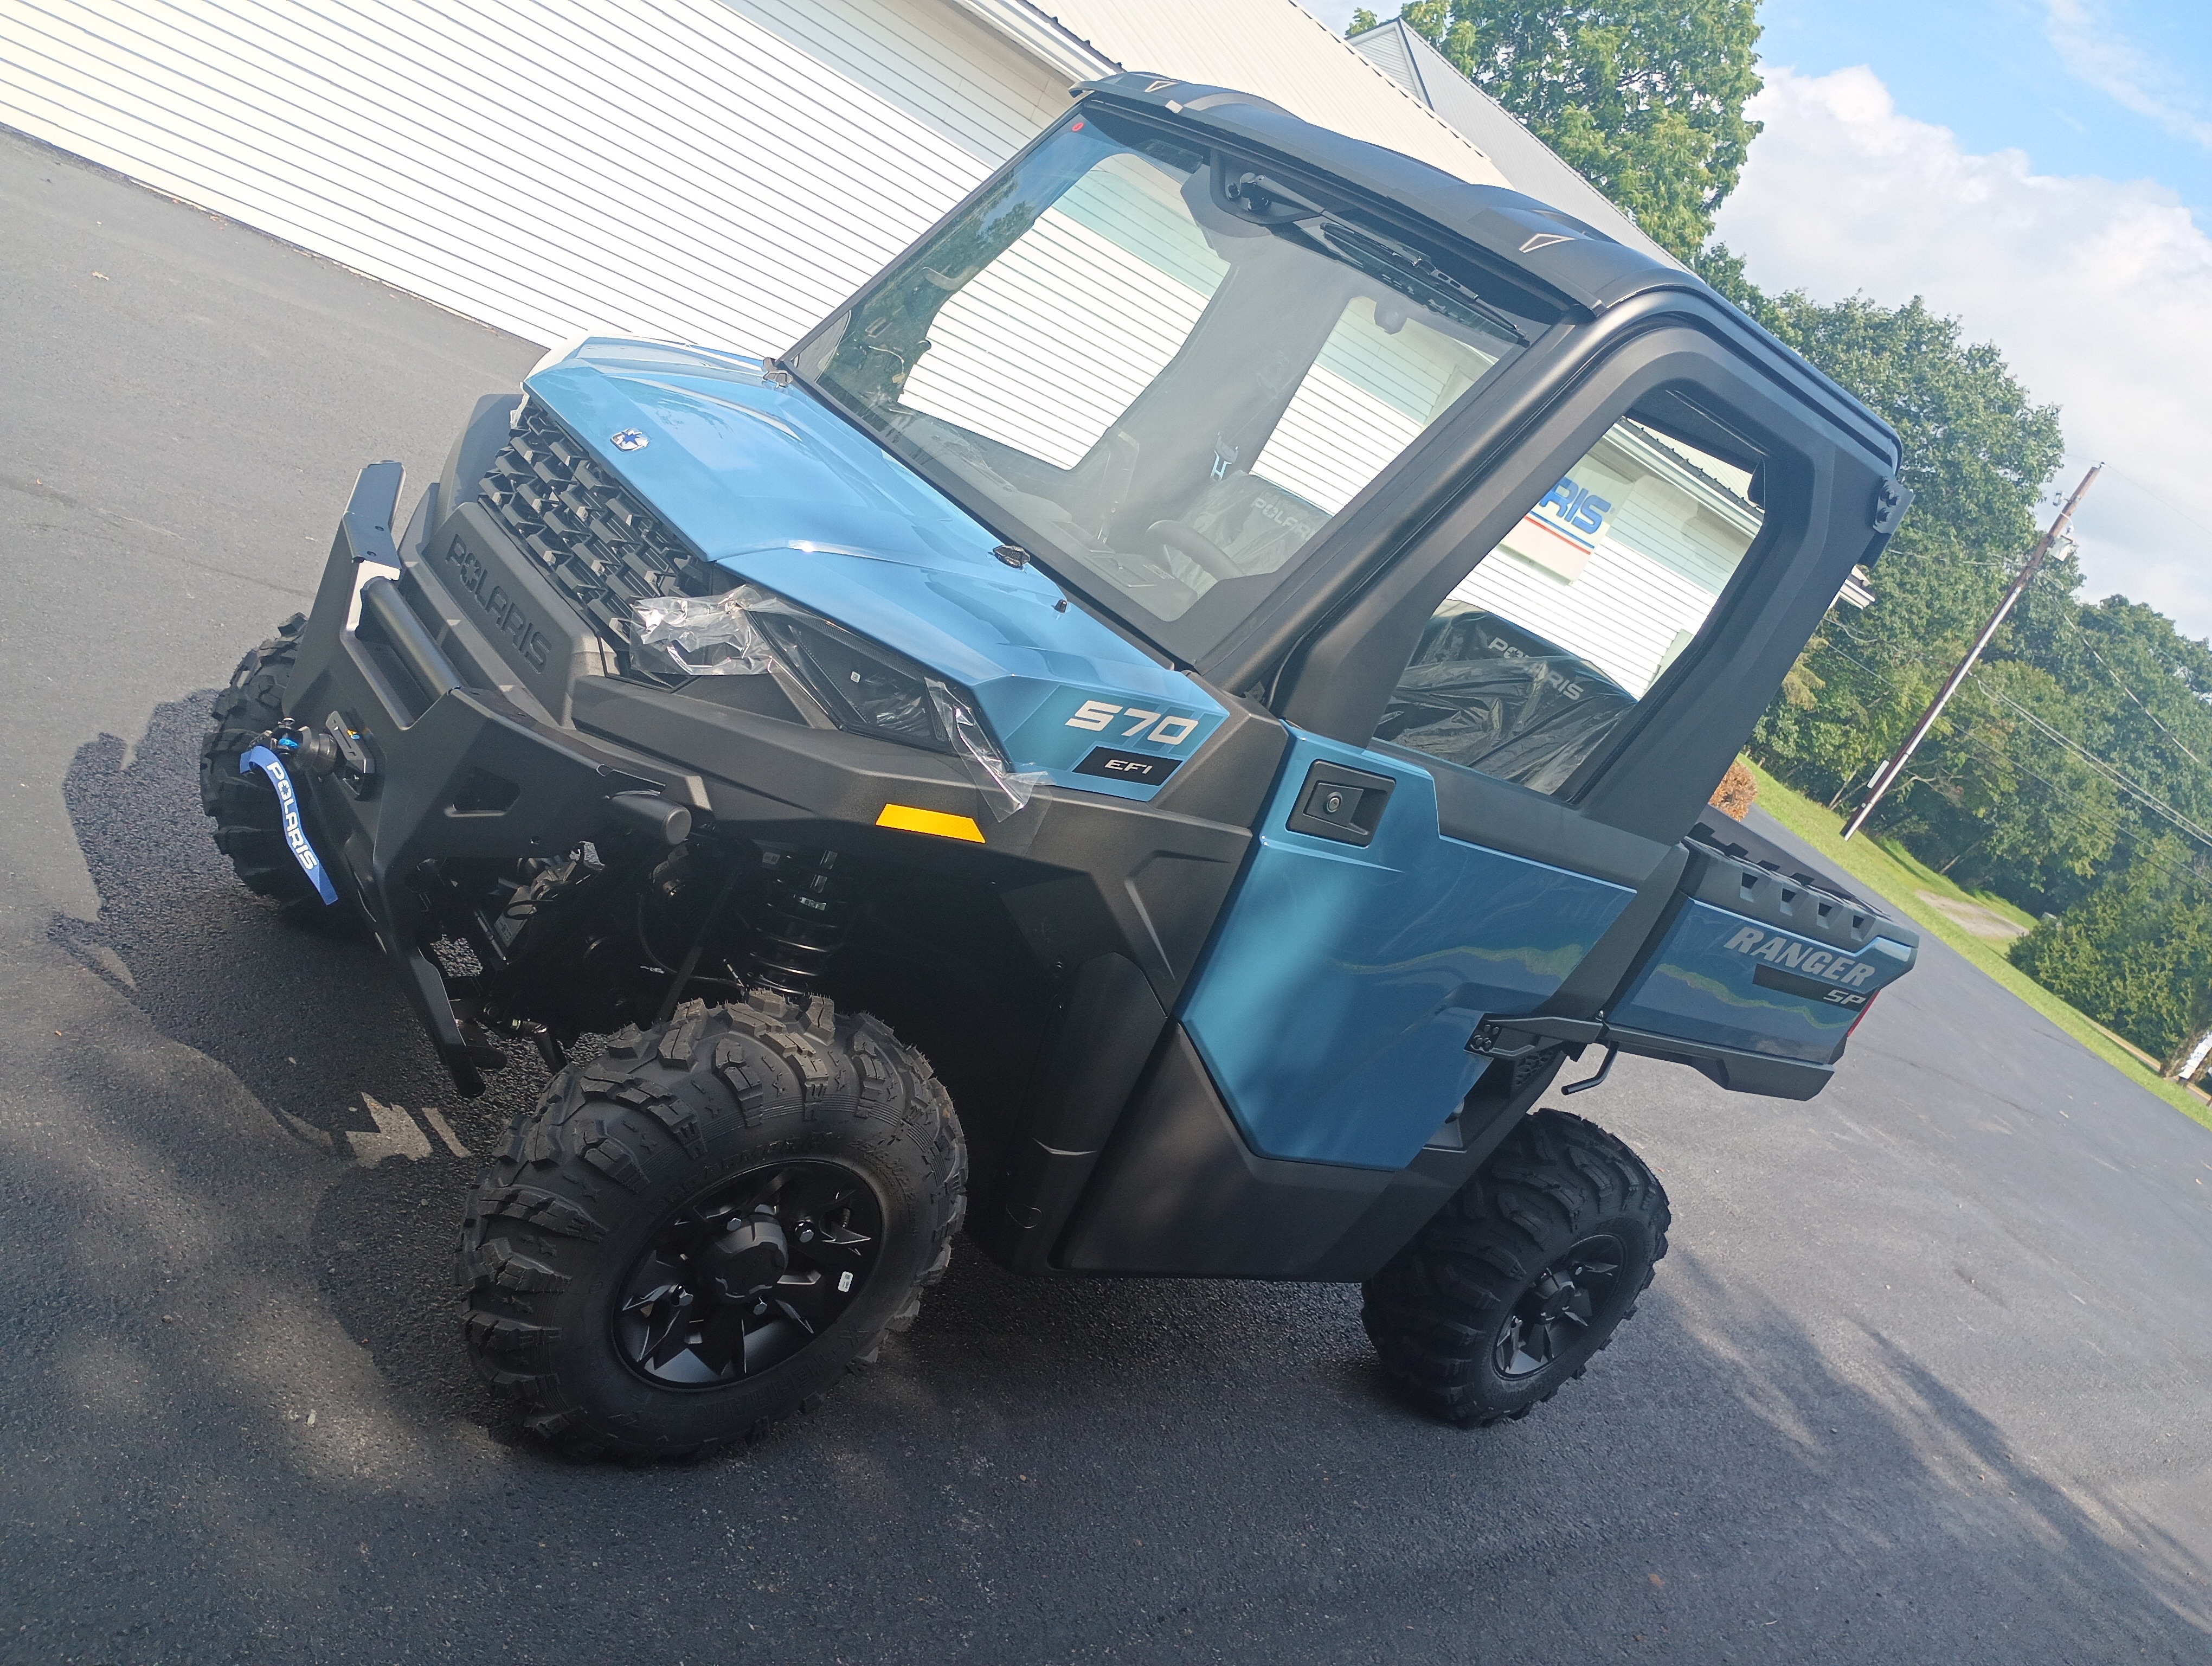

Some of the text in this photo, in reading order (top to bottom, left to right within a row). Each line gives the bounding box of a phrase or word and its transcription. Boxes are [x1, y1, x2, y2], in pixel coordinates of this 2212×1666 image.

[445, 533, 553, 675] POLARIS
[1488, 637, 1584, 700] PORIS
[1065, 700, 1199, 745] 570
[1104, 759, 1153, 774] EFI
[266, 761, 318, 870] POLARIS
[1723, 926, 1876, 987] RANGER
[1823, 989, 1867, 1005] SP
